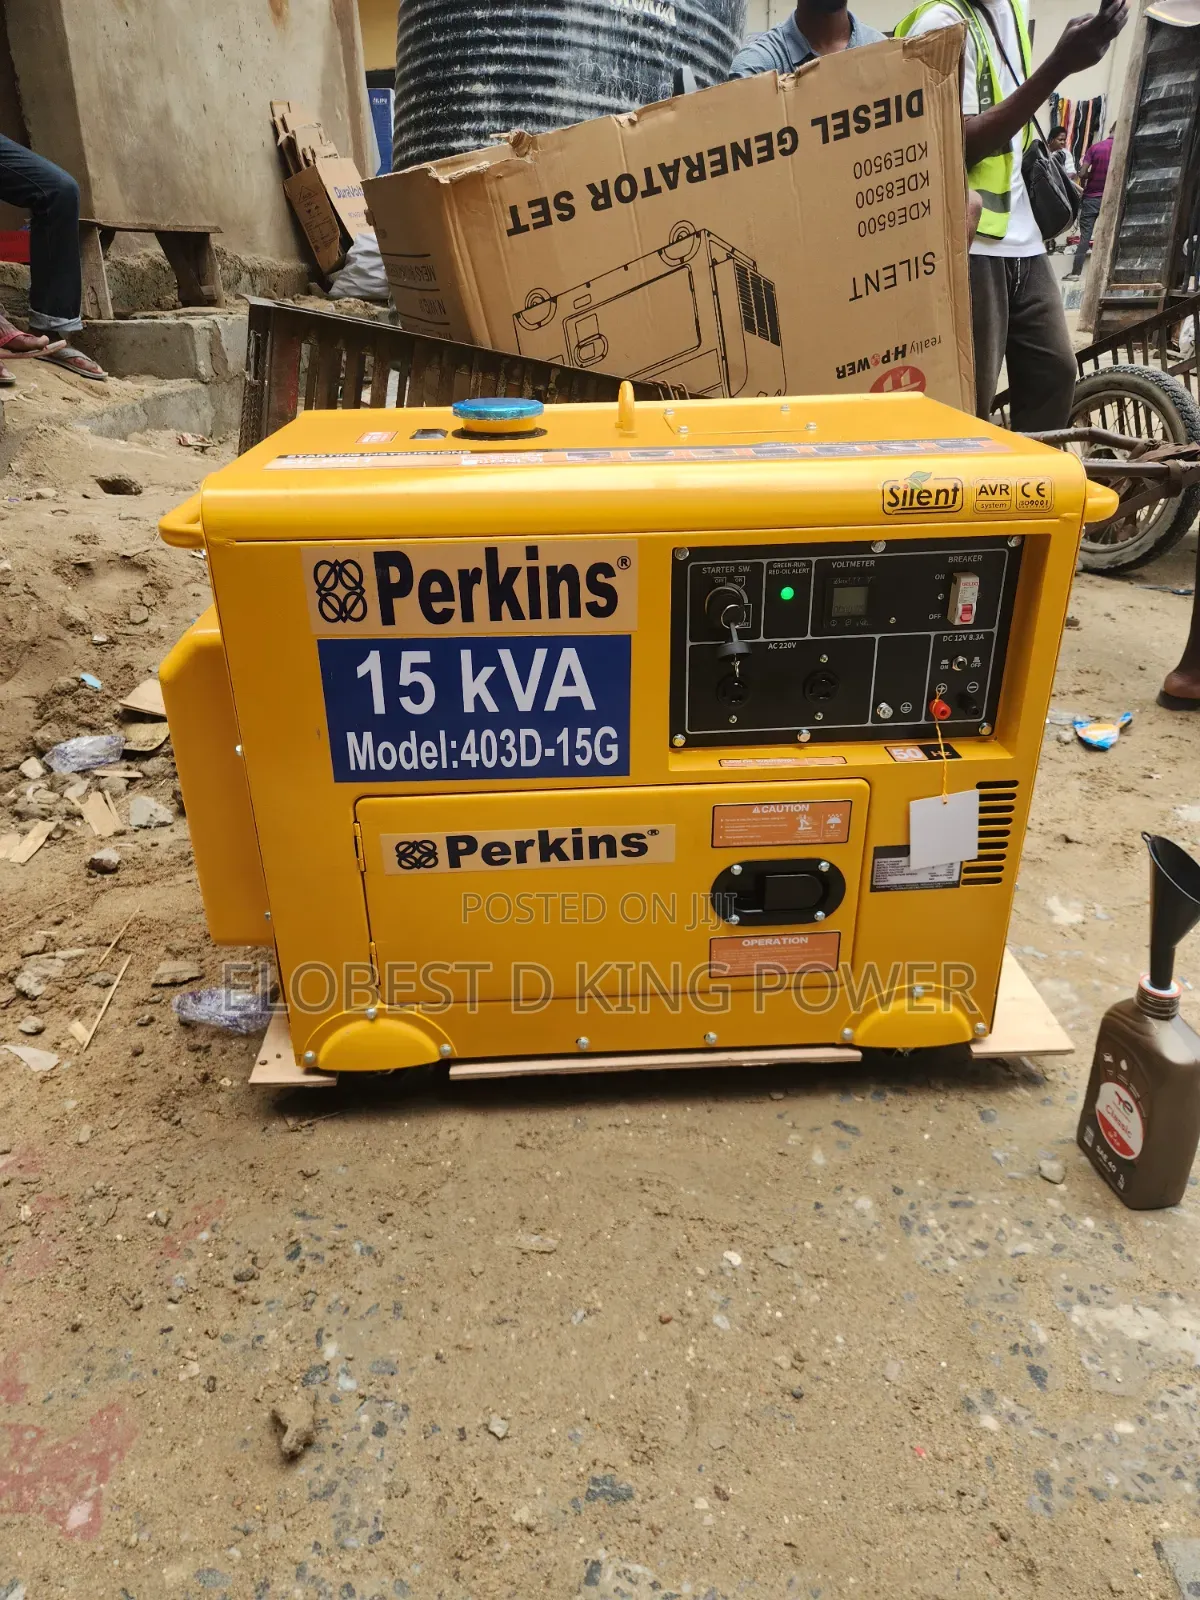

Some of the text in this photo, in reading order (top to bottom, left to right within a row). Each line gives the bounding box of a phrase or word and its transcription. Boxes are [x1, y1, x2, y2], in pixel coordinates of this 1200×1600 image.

[506, 88, 924, 237] DIESEL GENERATOR SET
[853, 141, 928, 180] KDE9500
[855, 169, 930, 209] KDE8500
[857, 198, 931, 238] KDE6500
[849, 251, 936, 302] SILENT
[909, 335, 942, 355] really
[887, 481, 960, 508] Silent
[977, 483, 1010, 497] AVR
[980, 502, 1007, 510] system
[831, 559, 876, 569] VOLTMETER
[947, 554, 983, 563] BREAKER
[701, 565, 752, 574] STARTER SW.
[791, 567, 810, 575] ALERT
[968, 633, 984, 641] 8.3A
[779, 642, 797, 650] 220V
[356, 647, 597, 715] 15 kVA
[892, 748, 922, 760] 50
[761, 803, 810, 814] CAUTION
[741, 936, 809, 947] OPERATION
